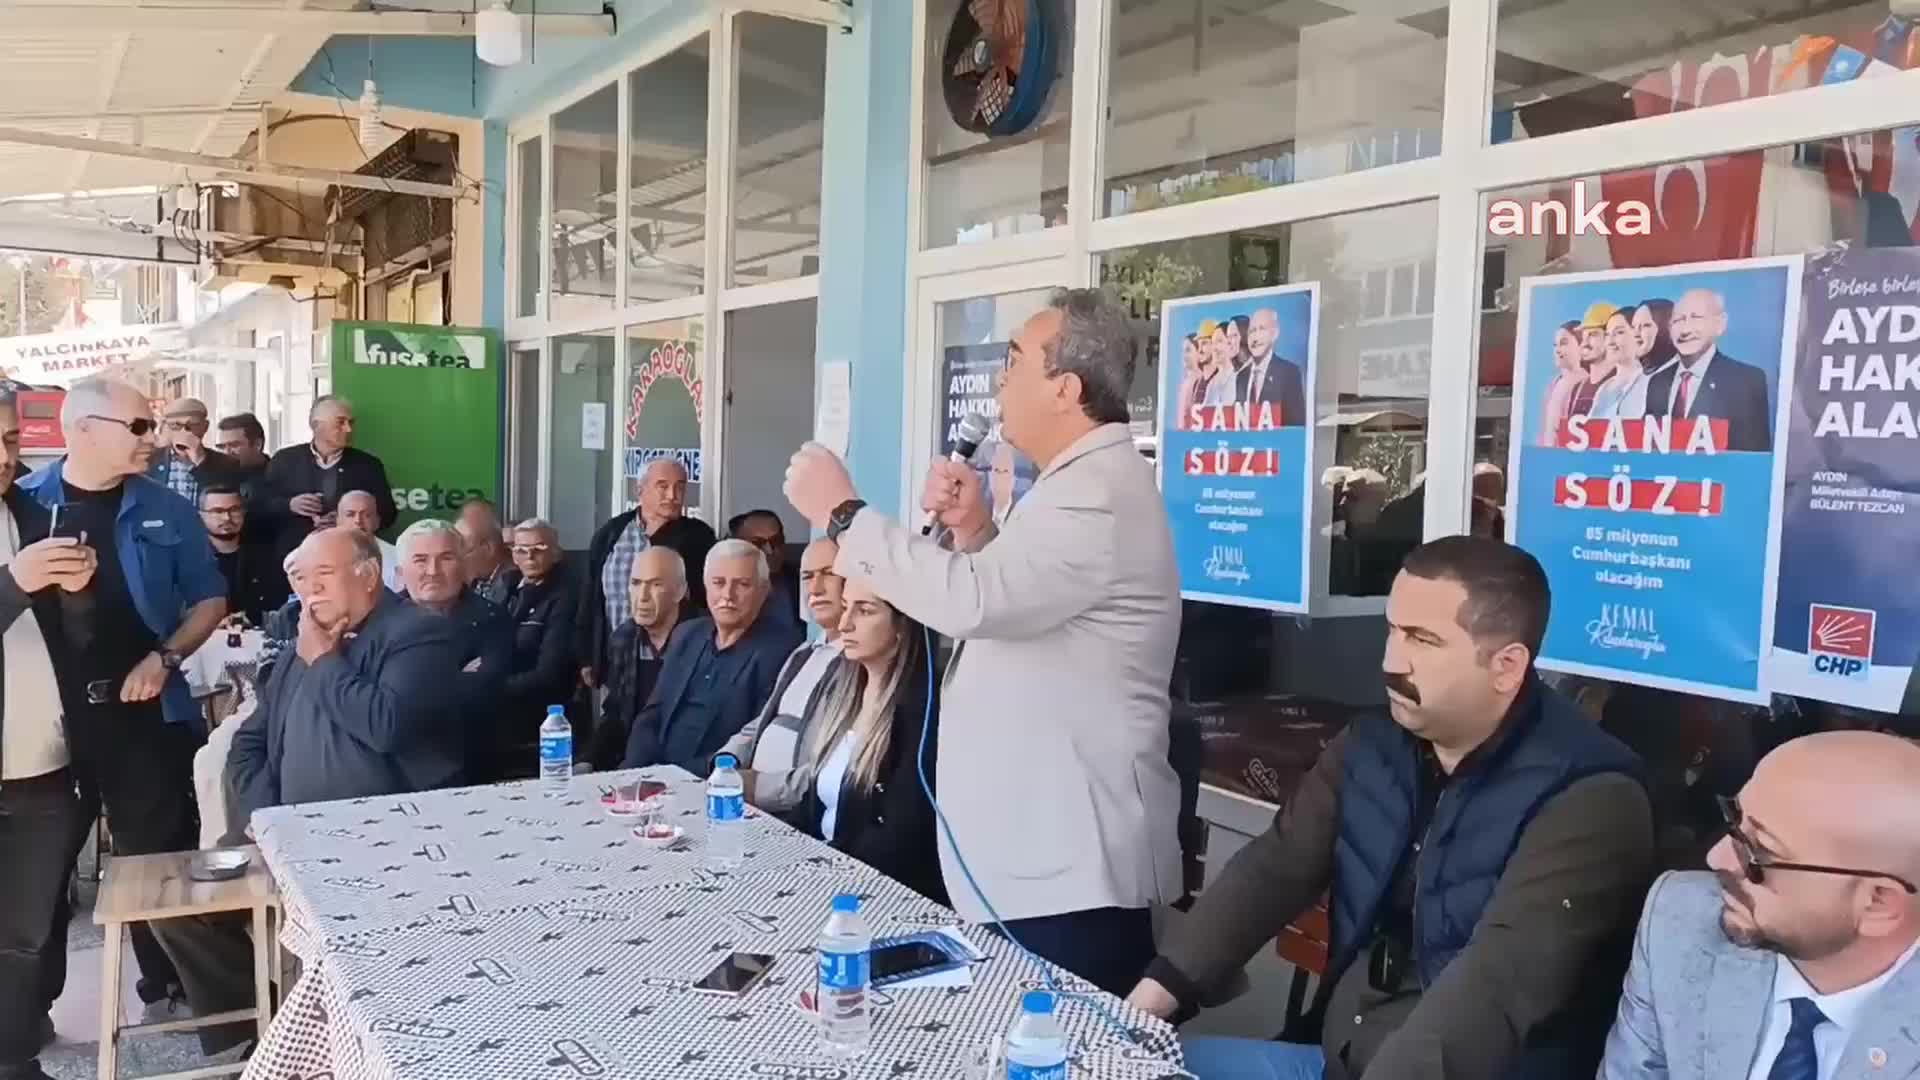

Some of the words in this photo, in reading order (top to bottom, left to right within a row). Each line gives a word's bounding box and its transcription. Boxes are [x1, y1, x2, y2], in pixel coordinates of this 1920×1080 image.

[42, 353, 130, 372] MARKET
[949, 374, 990, 394] AYDIN
[1190, 401, 1275, 432] SANA
[1814, 401, 1920, 439] ALA
[1566, 414, 1717, 455] SANA
[1188, 439, 1273, 477] SÖZ!
[1812, 471, 1848, 483] AYDIN
[390, 481, 484, 511] sete
[1563, 464, 1712, 517] SÖZ!
[1857, 501, 1905, 514] TEZCAN
[1607, 528, 1679, 547] milyonun
[1572, 546, 1691, 570] Cumhurbaşkanı
[1595, 570, 1664, 590] olacağım
[1601, 603, 1656, 634] KEMAL
[1814, 655, 1862, 676] CHP
